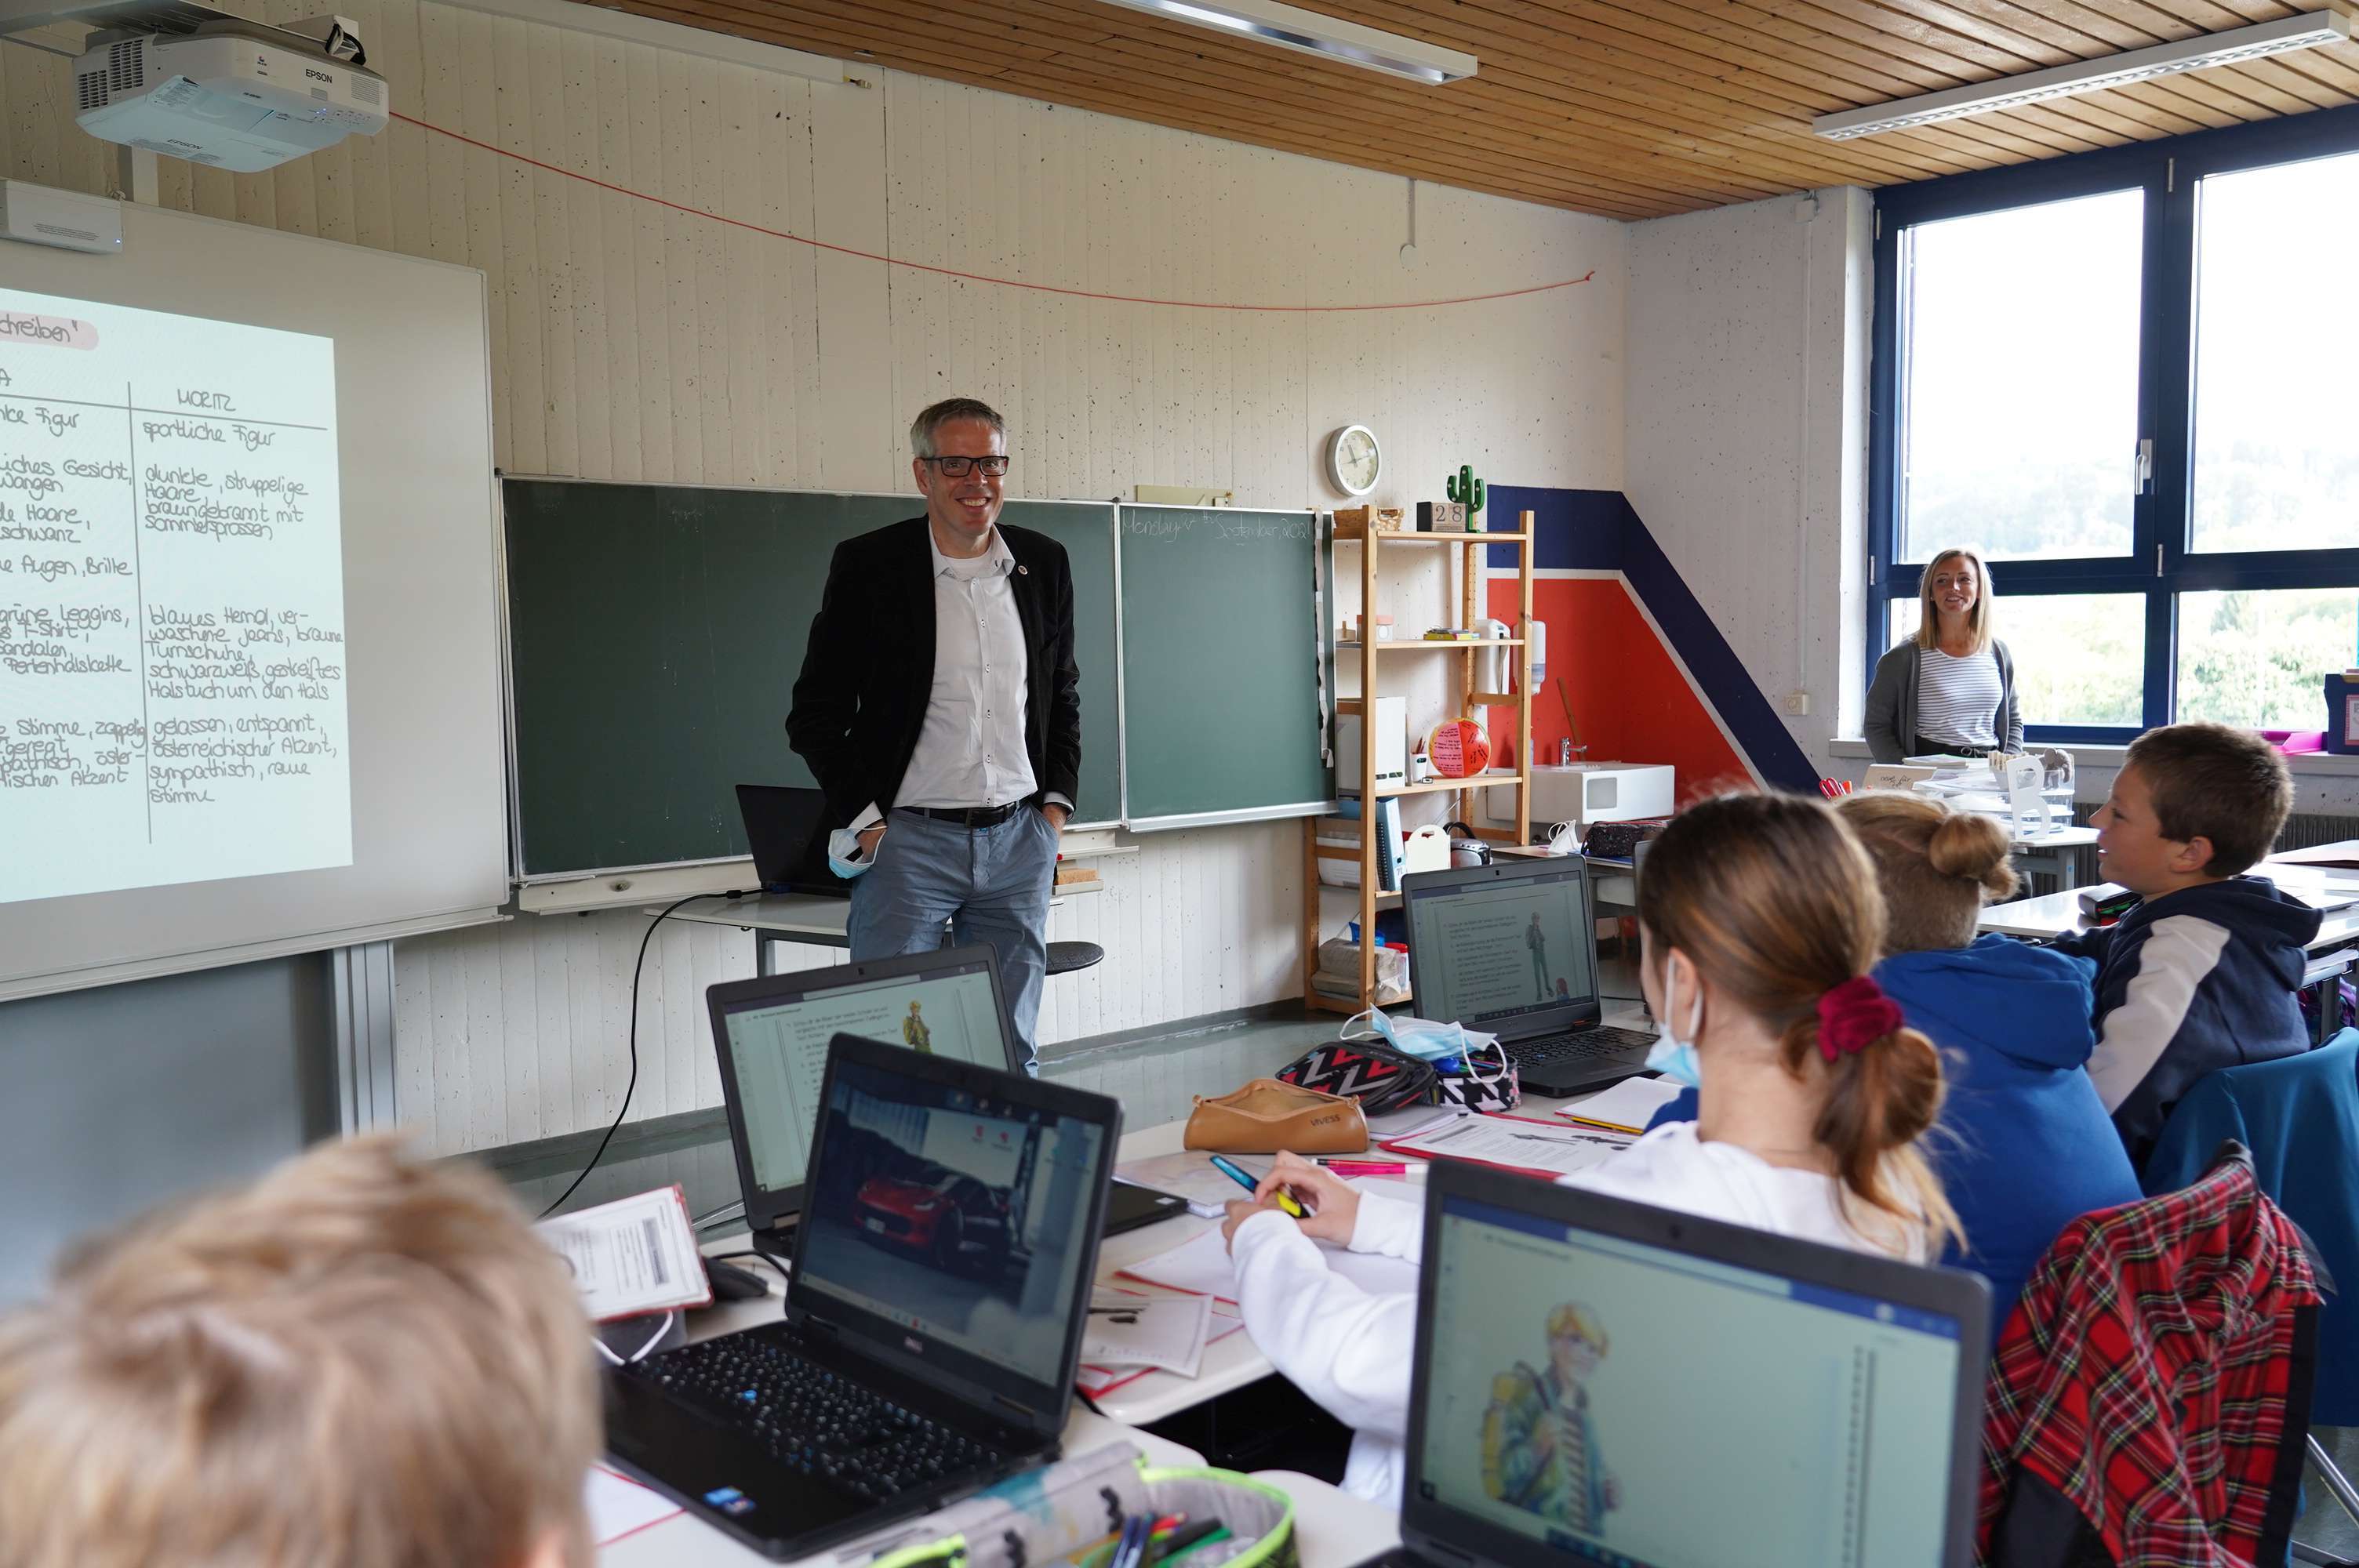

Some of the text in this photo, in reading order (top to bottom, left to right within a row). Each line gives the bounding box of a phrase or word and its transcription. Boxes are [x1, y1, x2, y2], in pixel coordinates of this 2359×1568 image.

[305, 68, 333, 84] EPSON
[167, 138, 203, 151] EPSON
[177, 388, 236, 412] MORITZ
[35, 406, 80, 437] Figur
[143, 419, 276, 452] sportliche Figur
[275, 504, 304, 523] mit
[0, 522, 82, 543] schwanz
[60, 604, 129, 630] Leggins,
[148, 604, 309, 631] blaues Hemd, ver-
[149, 626, 231, 642] waschene
[295, 624, 343, 643] braune
[3, 655, 132, 675] Perlenhalskette
[263, 682, 293, 699] den
[297, 681, 329, 700] Hals
[95, 717, 147, 750] zappelig
[152, 737, 275, 758] österreichischer
[71, 764, 129, 787] Akzent
[267, 761, 311, 776] raue
[150, 787, 216, 804] Stimme
